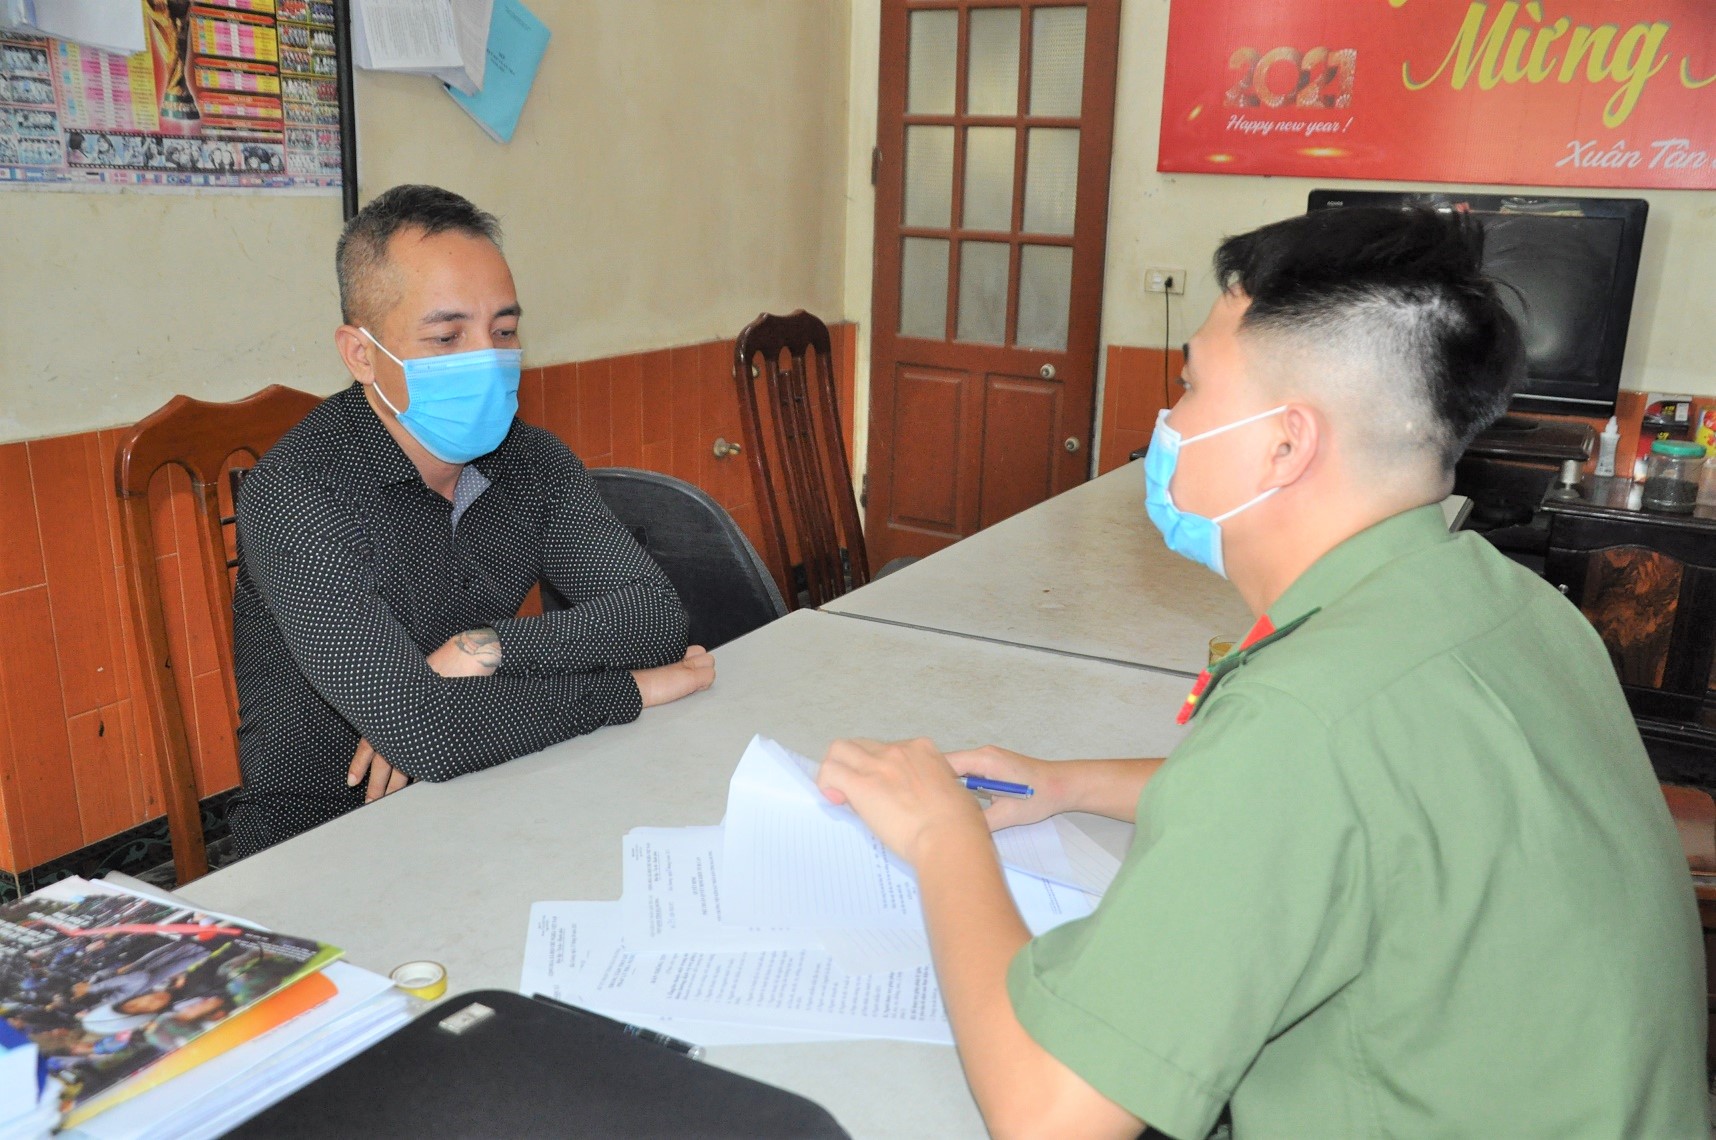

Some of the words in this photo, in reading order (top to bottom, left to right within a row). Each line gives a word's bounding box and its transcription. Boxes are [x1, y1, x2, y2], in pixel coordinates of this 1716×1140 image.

[1223, 46, 1357, 108] 2021
[1402, 0, 1670, 129] Mừng
[1226, 114, 1274, 136] Happy
[1275, 121, 1305, 132] new
[1555, 139, 1643, 168] Xuân
[1648, 137, 1710, 169] Tân
